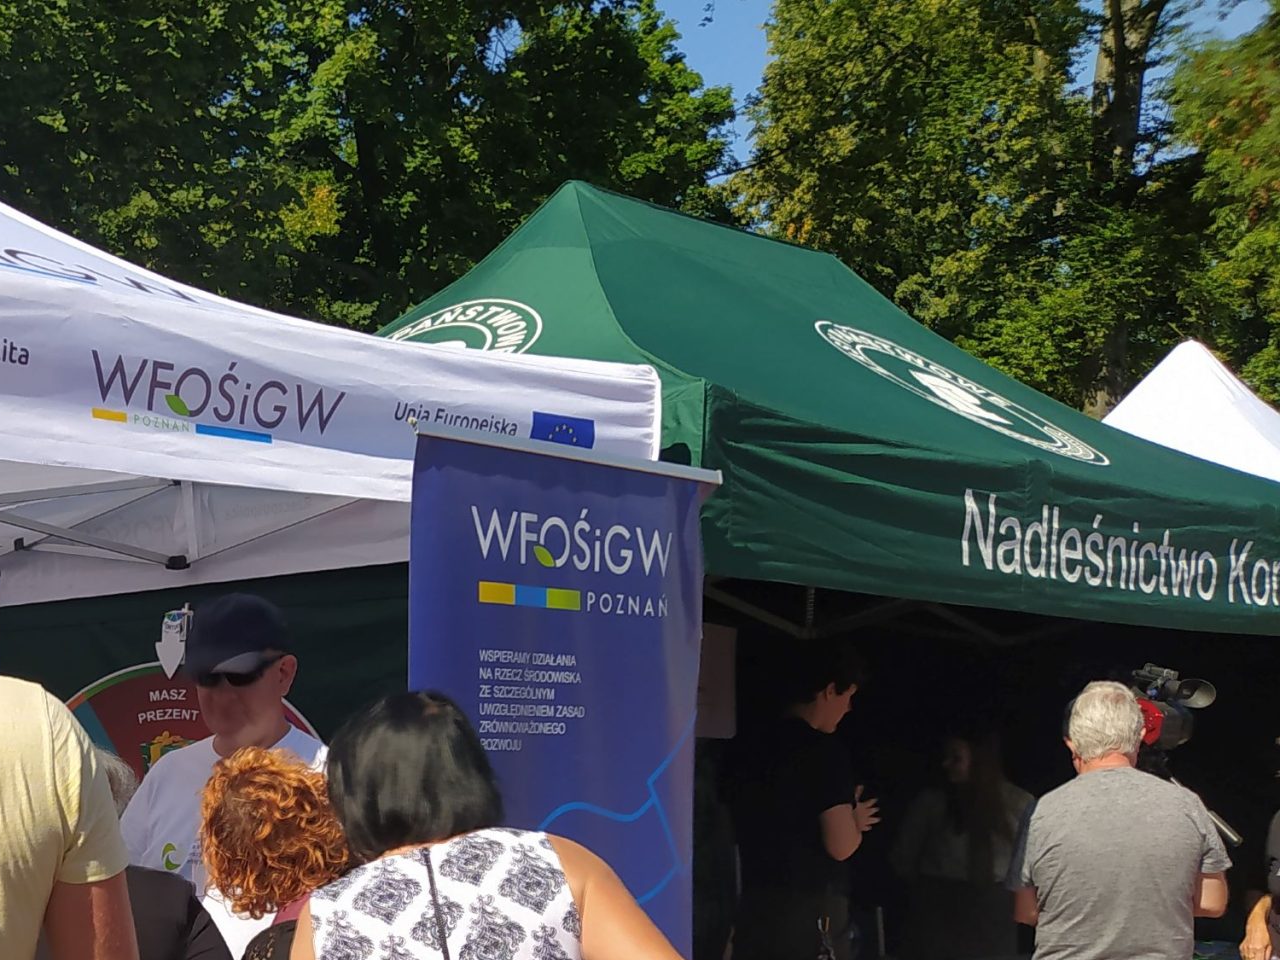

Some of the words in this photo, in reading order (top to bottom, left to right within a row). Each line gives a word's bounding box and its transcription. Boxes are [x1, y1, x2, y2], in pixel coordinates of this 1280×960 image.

[91, 349, 347, 436] WFOŚiGW
[471, 505, 673, 577] WFOŚiGW
[961, 487, 1218, 601] Nadleśnictwo
[586, 592, 669, 617] POZNAŃ
[479, 649, 531, 664] WSPIERAMY
[532, 653, 577, 667] DZIAŁANIA
[479, 667, 493, 680] NA
[494, 668, 523, 681] RZECZ
[524, 668, 582, 684] ŚRODOWISKA
[149, 689, 187, 702] MASZ
[479, 685, 491, 698] ZE
[493, 685, 555, 700] SZCZEGÓLNYM
[137, 708, 199, 724] PREZENT
[556, 705, 585, 718] ZASAD
[480, 738, 522, 751] ROZWOJU
